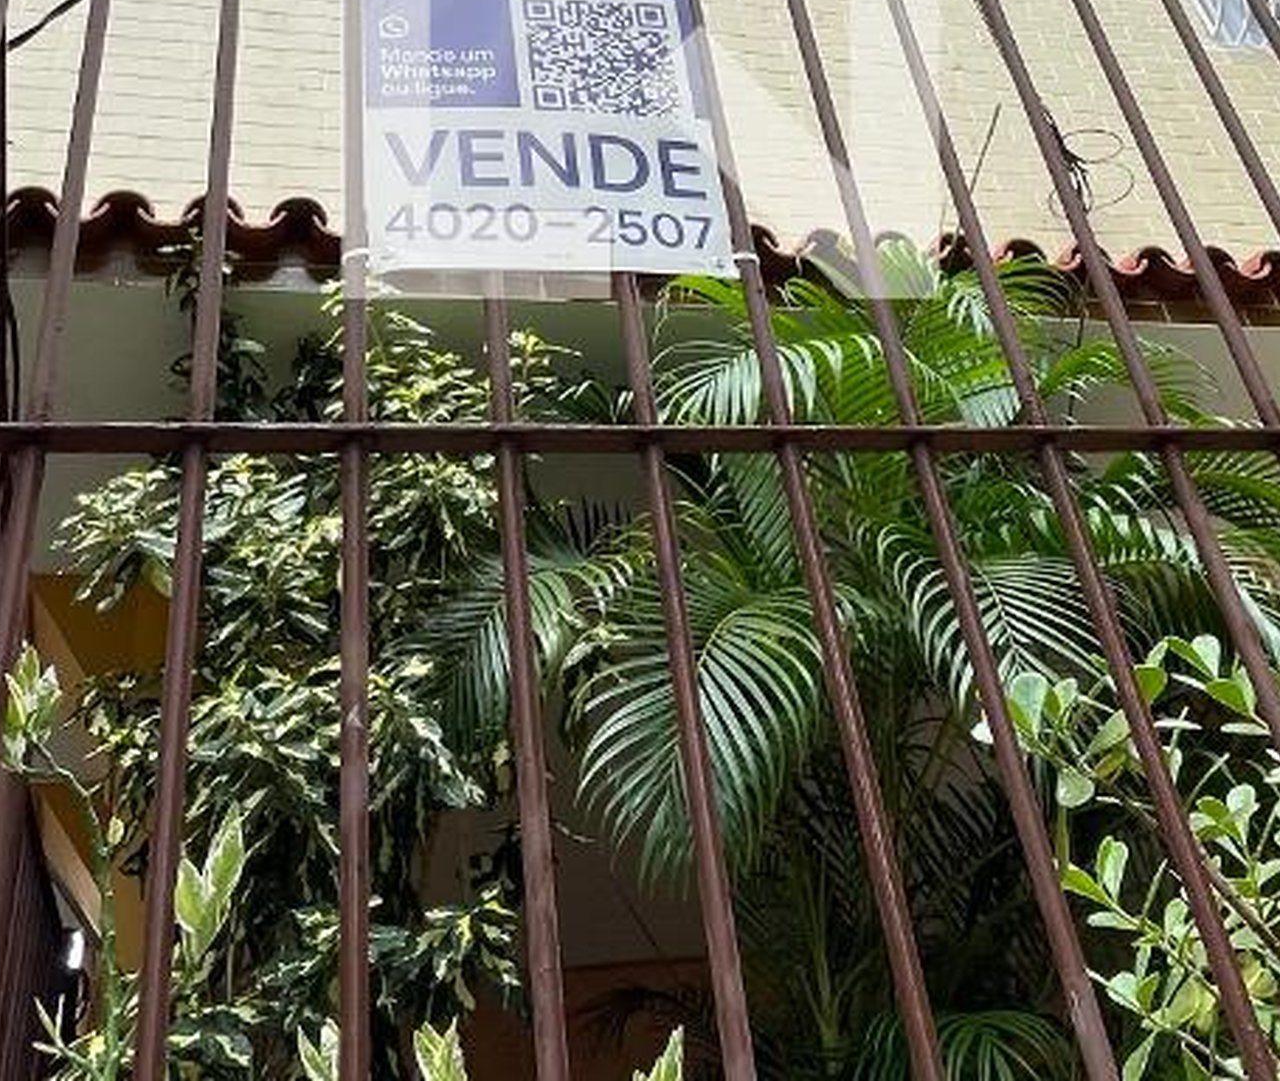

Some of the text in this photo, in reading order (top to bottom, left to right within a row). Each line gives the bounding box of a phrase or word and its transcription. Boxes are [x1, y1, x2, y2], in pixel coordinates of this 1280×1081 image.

[461, 49, 495, 62] um
[381, 83, 409, 96] ou
[384, 129, 708, 201] VENDE
[385, 202, 713, 250] 4020-2507
